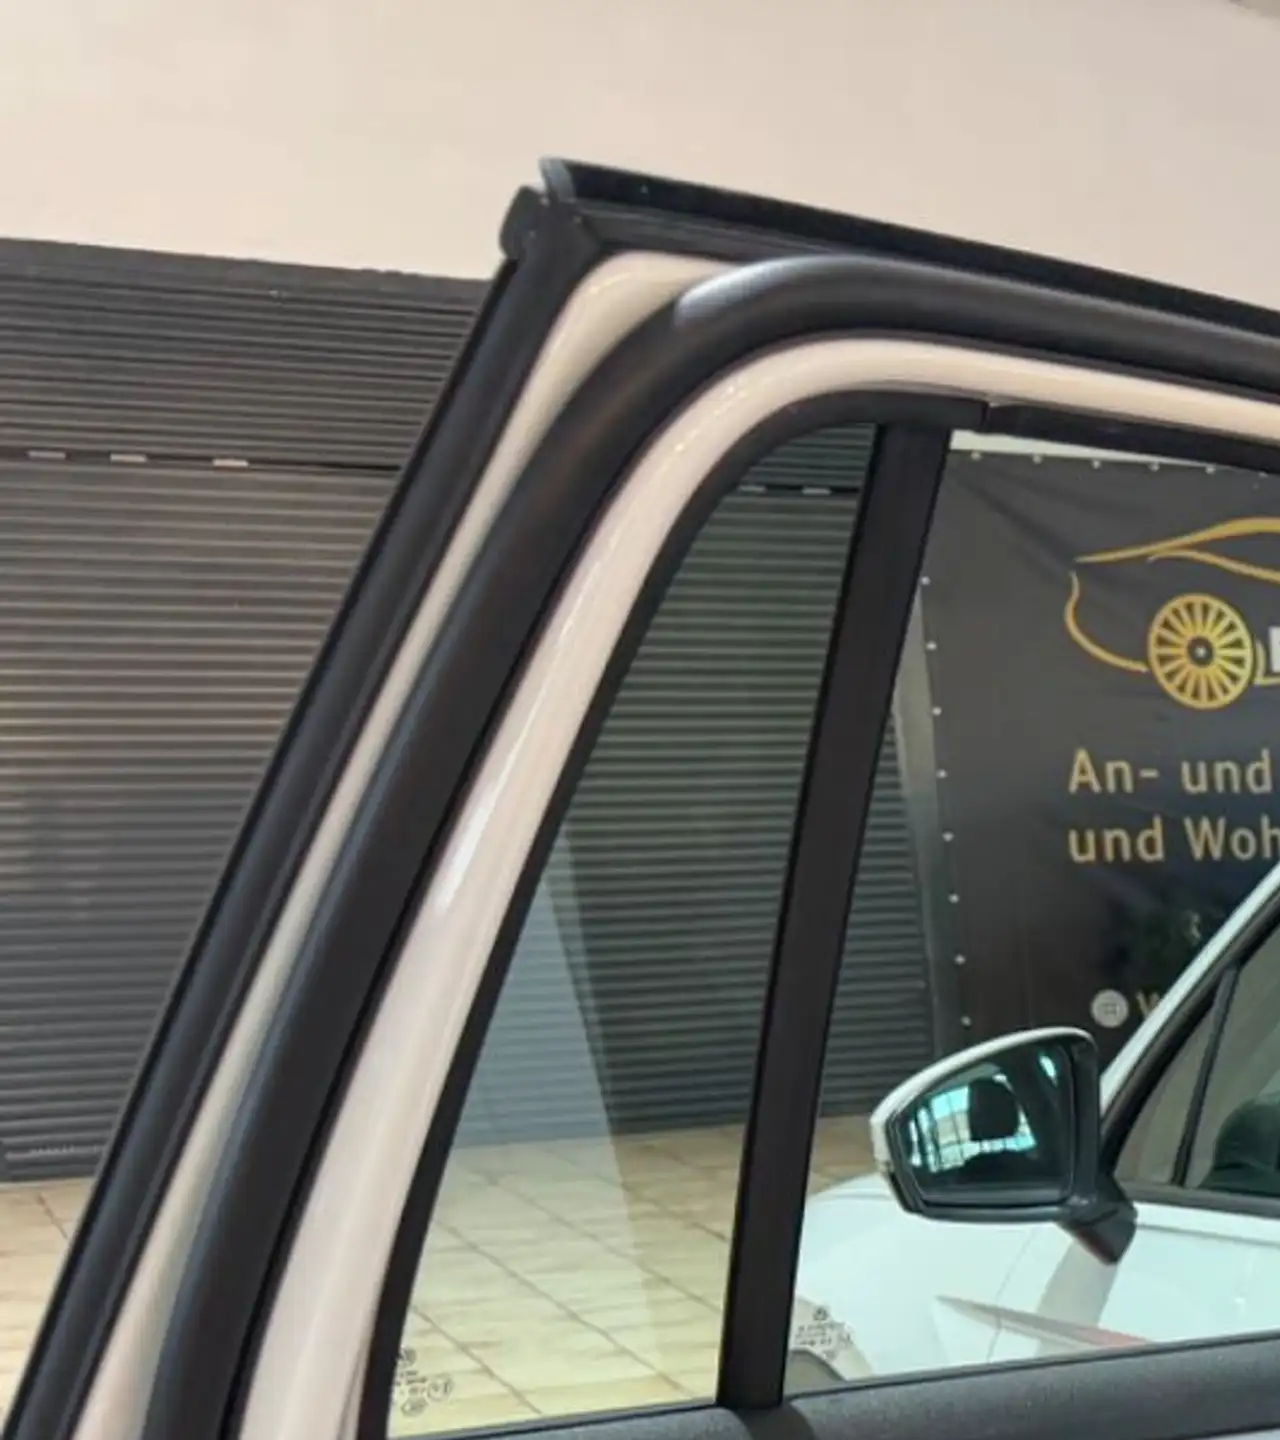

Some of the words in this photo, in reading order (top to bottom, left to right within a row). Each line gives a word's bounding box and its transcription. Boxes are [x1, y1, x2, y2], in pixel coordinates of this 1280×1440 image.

[1067, 748, 1160, 794] An-
[1180, 748, 1274, 794] und
[1068, 814, 1166, 864] und
